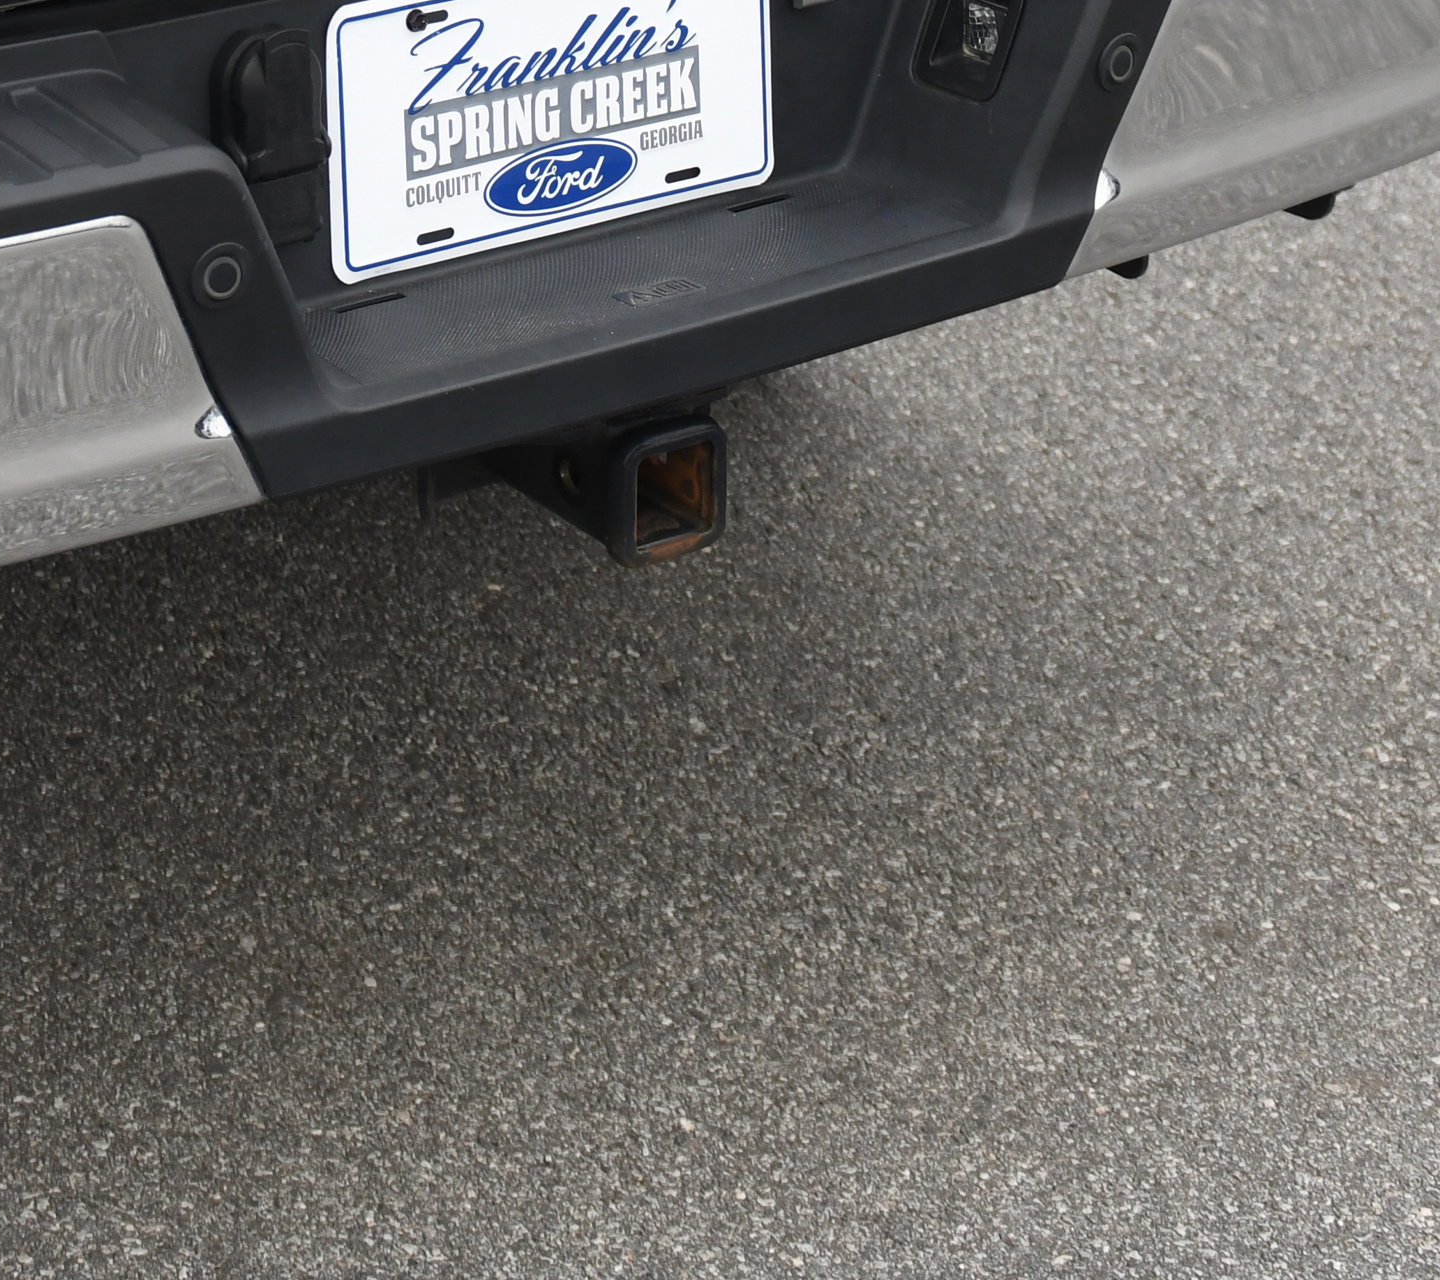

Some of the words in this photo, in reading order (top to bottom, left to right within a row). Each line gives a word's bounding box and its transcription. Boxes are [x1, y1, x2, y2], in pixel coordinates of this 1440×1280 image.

[411, 87, 561, 172] SPRING
[569, 57, 698, 136] CREEK
[639, 119, 704, 152] GEORGIA
[405, 171, 482, 208] COLQUITT
[516, 150, 604, 206] Ford
